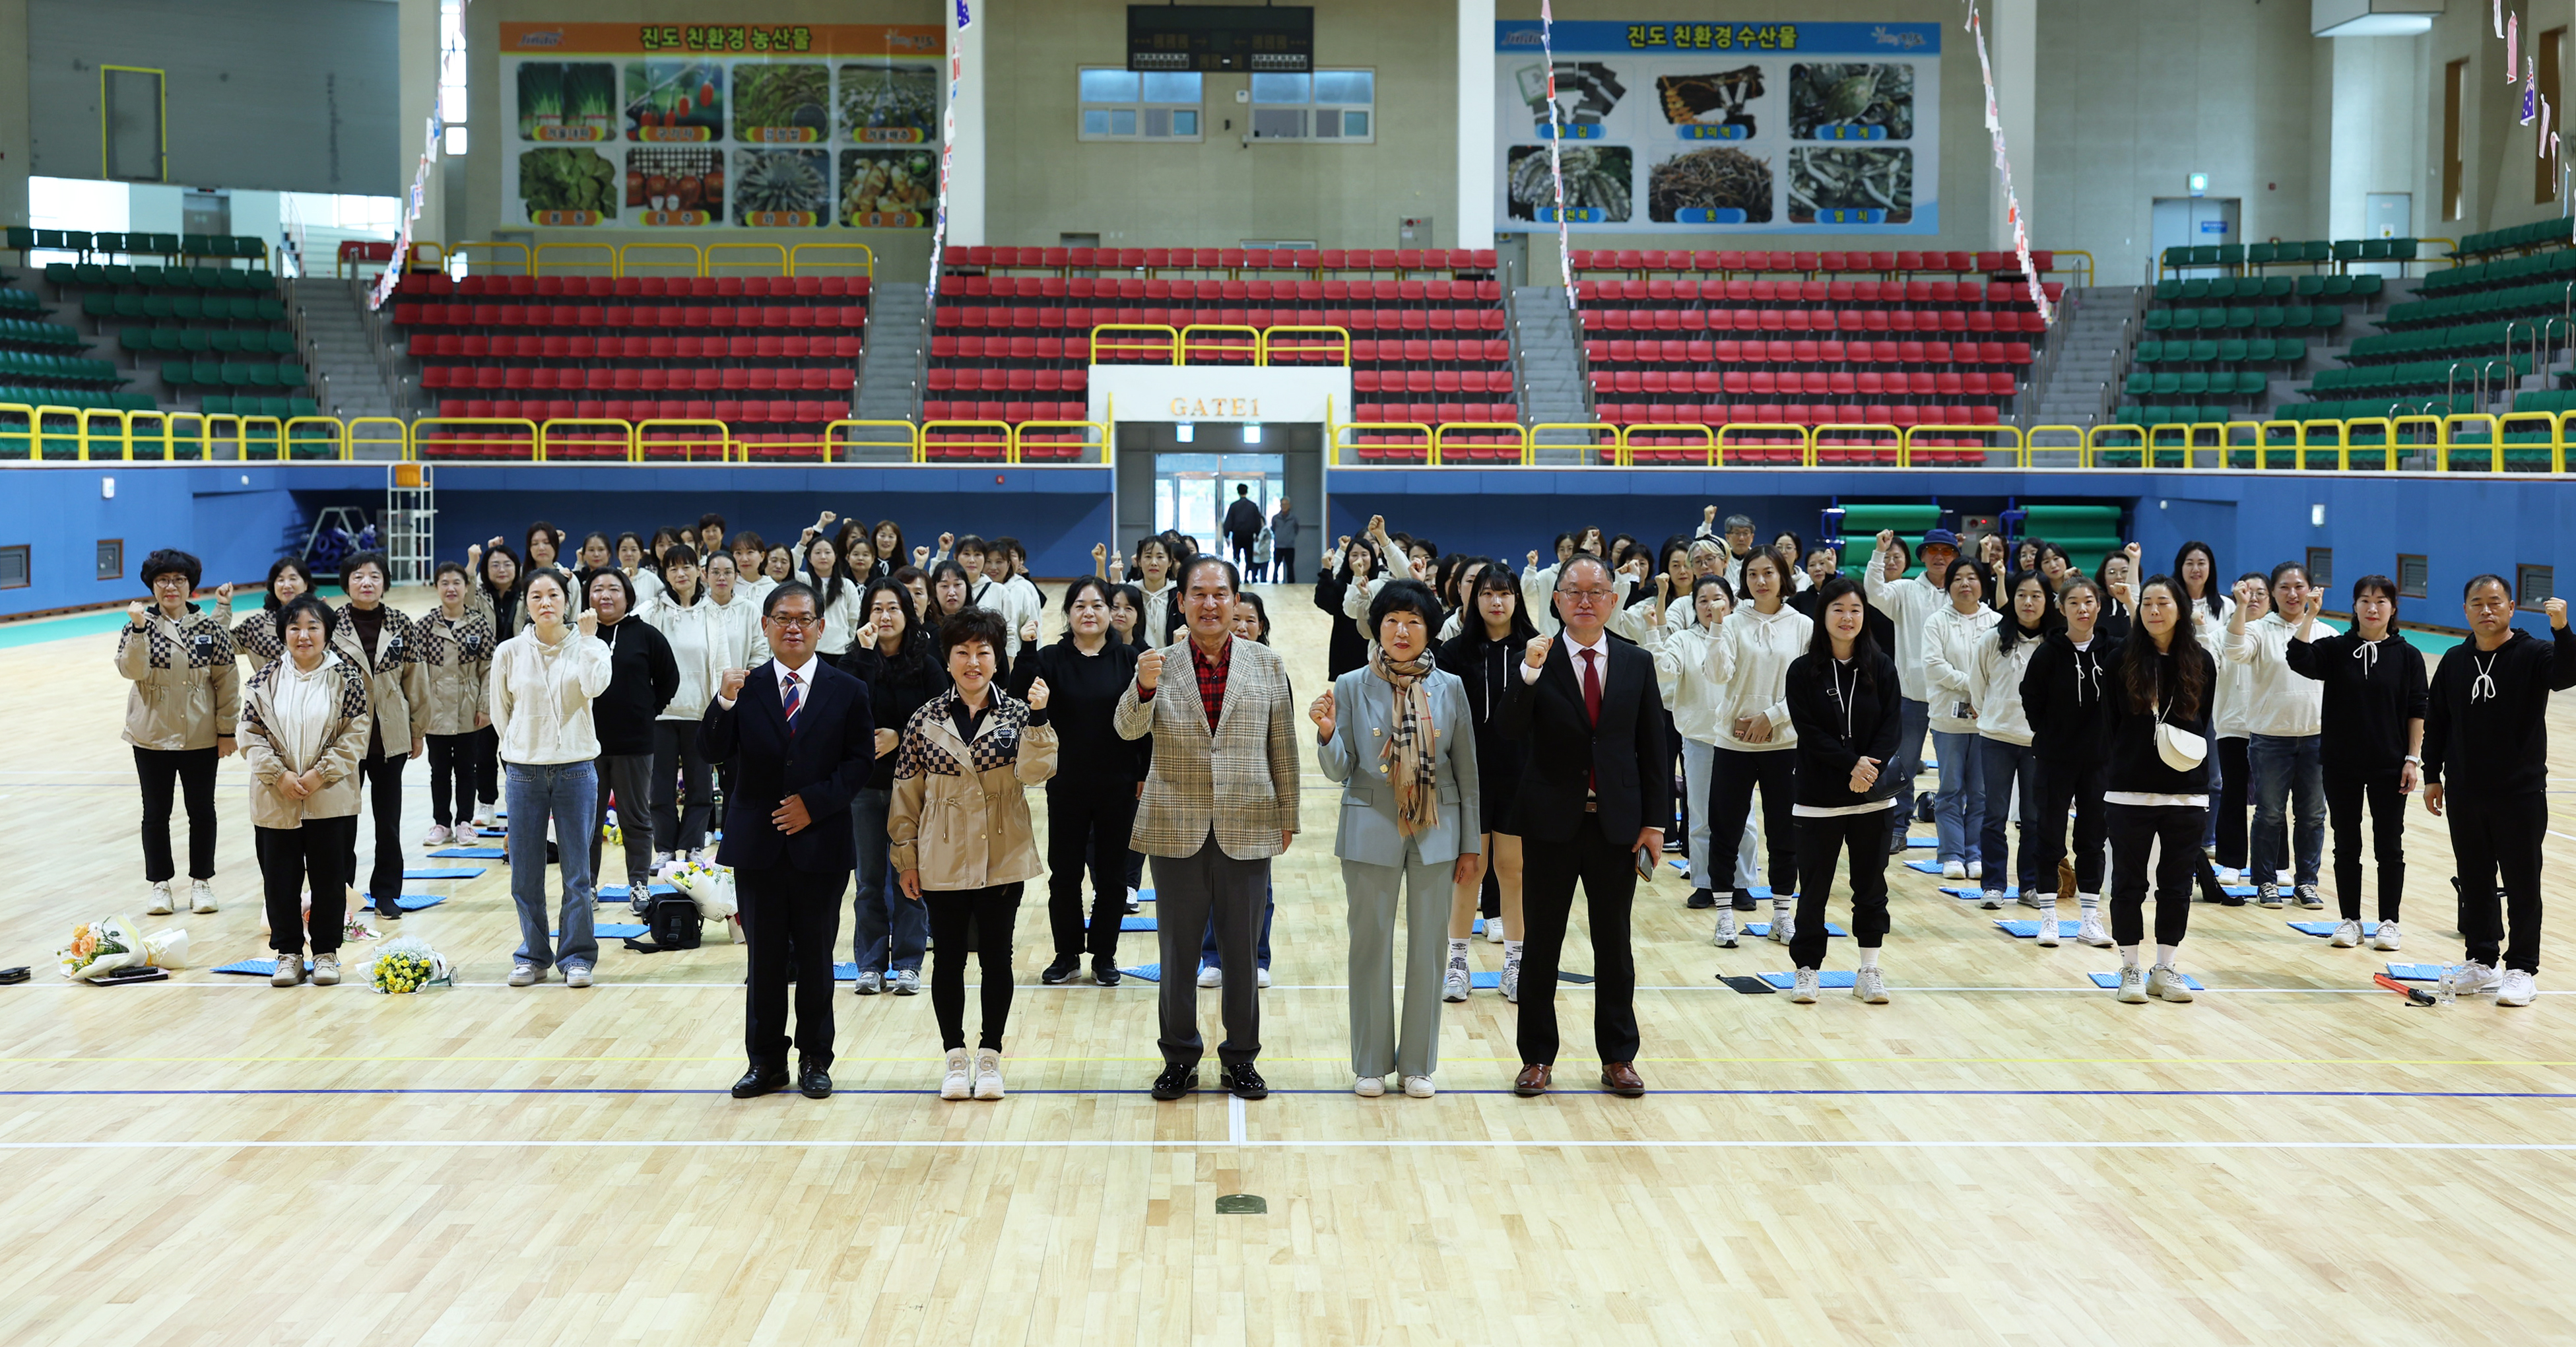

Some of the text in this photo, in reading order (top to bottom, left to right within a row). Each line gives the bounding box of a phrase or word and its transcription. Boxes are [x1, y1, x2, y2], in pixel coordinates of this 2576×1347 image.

[642, 27, 811, 51] 진도 친환경 농산물
[1628, 24, 1798, 49] 진도 친환경 수산물
[1694, 125, 1731, 139] 돌미역
[1170, 397, 1260, 417] GATE1
